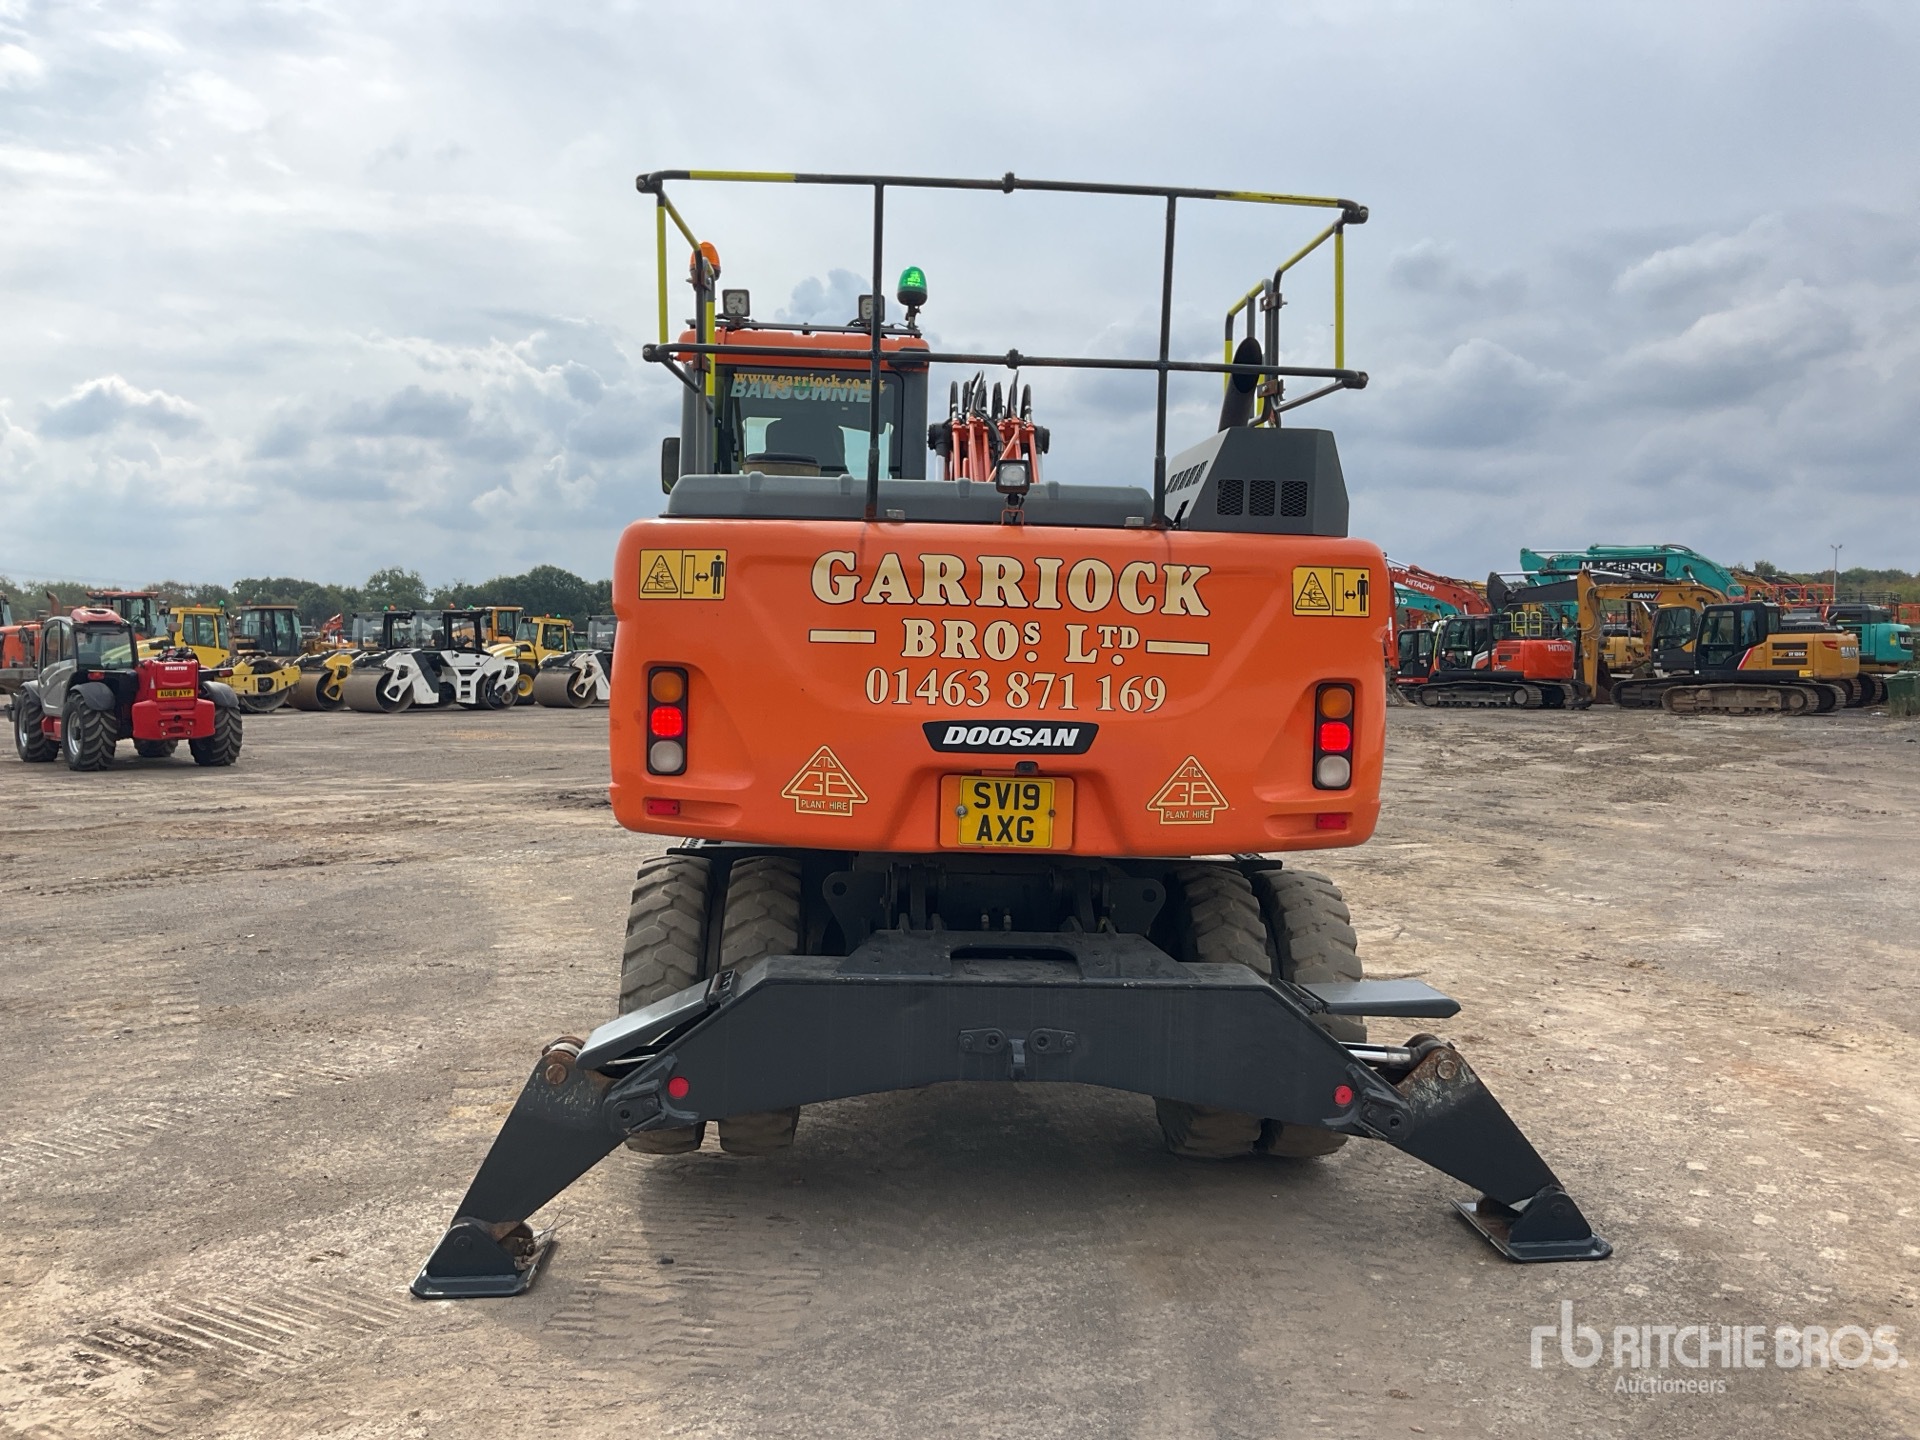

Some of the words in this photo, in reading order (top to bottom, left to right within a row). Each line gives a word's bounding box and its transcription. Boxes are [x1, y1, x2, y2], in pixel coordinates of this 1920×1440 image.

[811, 551, 1211, 617] GARRIOCK
[1405, 578, 1435, 591] HITACHI
[866, 667, 990, 708] 01463
[1005, 671, 1077, 711] 871
[1096, 676, 1167, 713] 169
[943, 726, 1080, 747] DOOSAN
[790, 771, 859, 798] GB
[973, 782, 1041, 811] SV19
[1156, 782, 1221, 806] GB
[801, 799, 826, 809] PLANT
[829, 801, 848, 811] HIRE
[1165, 810, 1190, 819] PLANT
[1192, 809, 1210, 819] HIRE
[976, 814, 1035, 843] AXG
